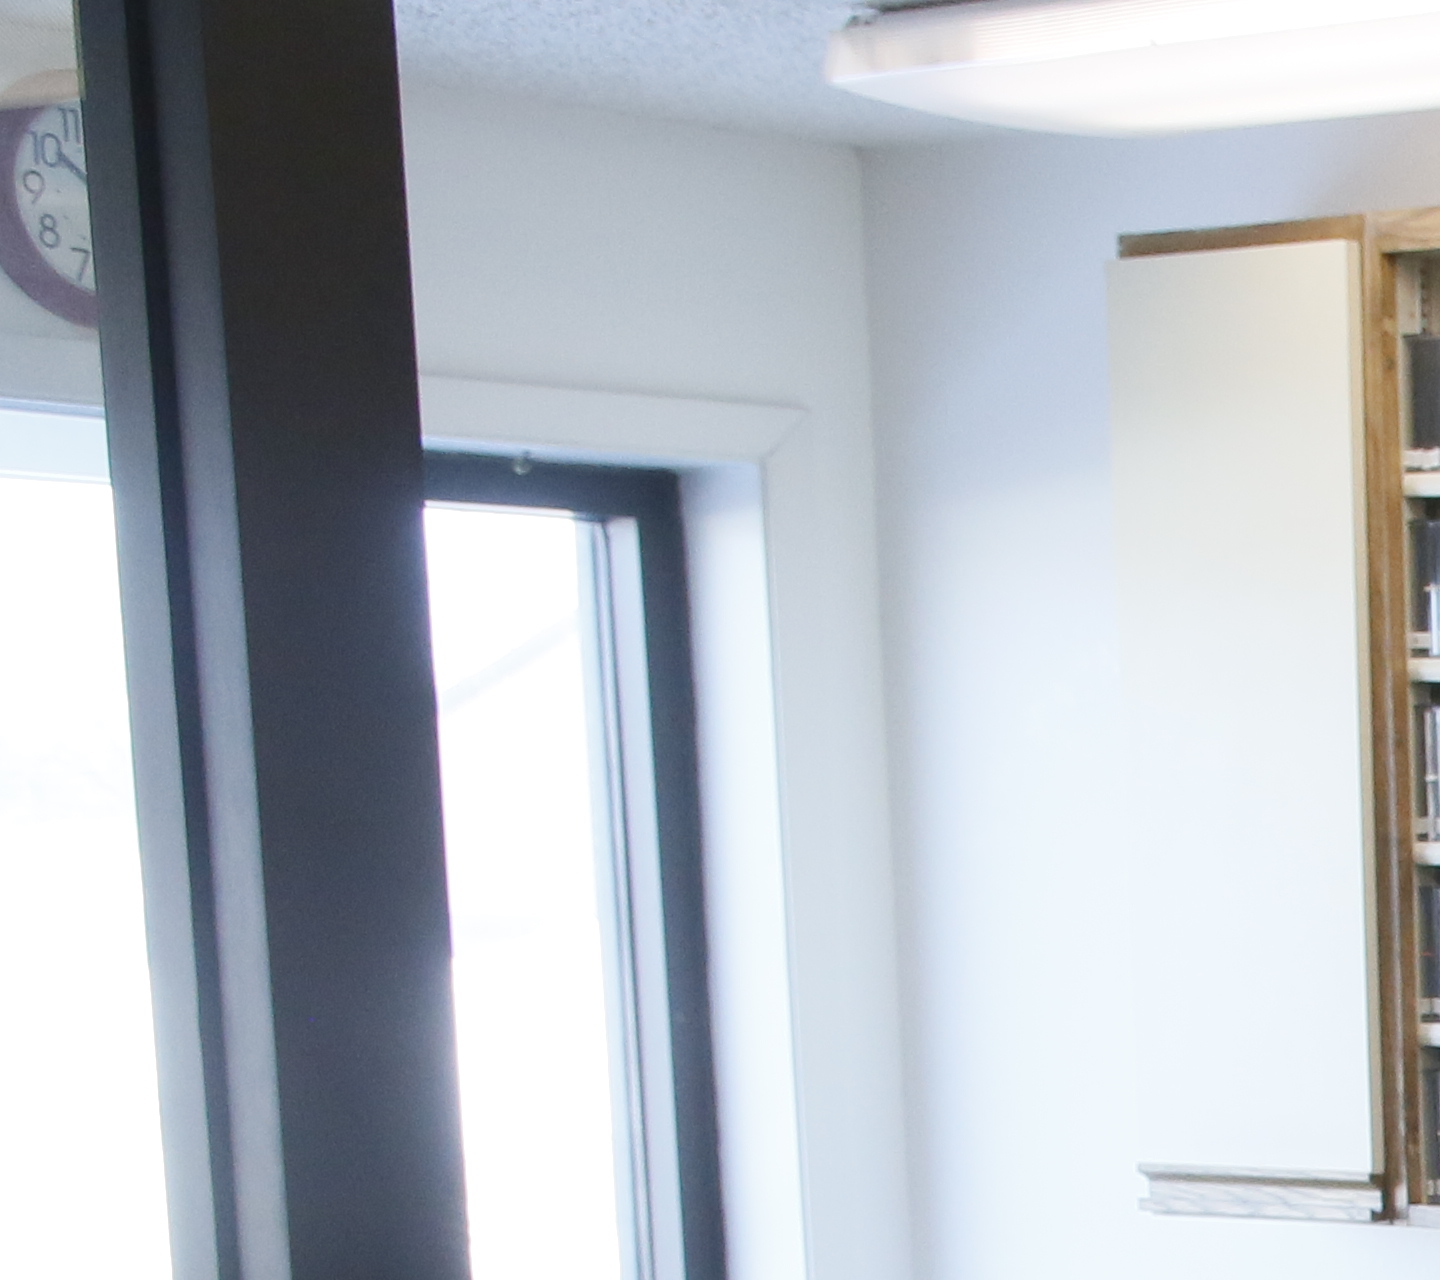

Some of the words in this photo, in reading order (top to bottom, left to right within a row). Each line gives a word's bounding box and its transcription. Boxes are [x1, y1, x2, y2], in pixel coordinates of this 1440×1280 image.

[29, 130, 62, 168] 10
[22, 168, 47, 205] 9
[39, 212, 61, 249] 8
[71, 246, 91, 283] 7
